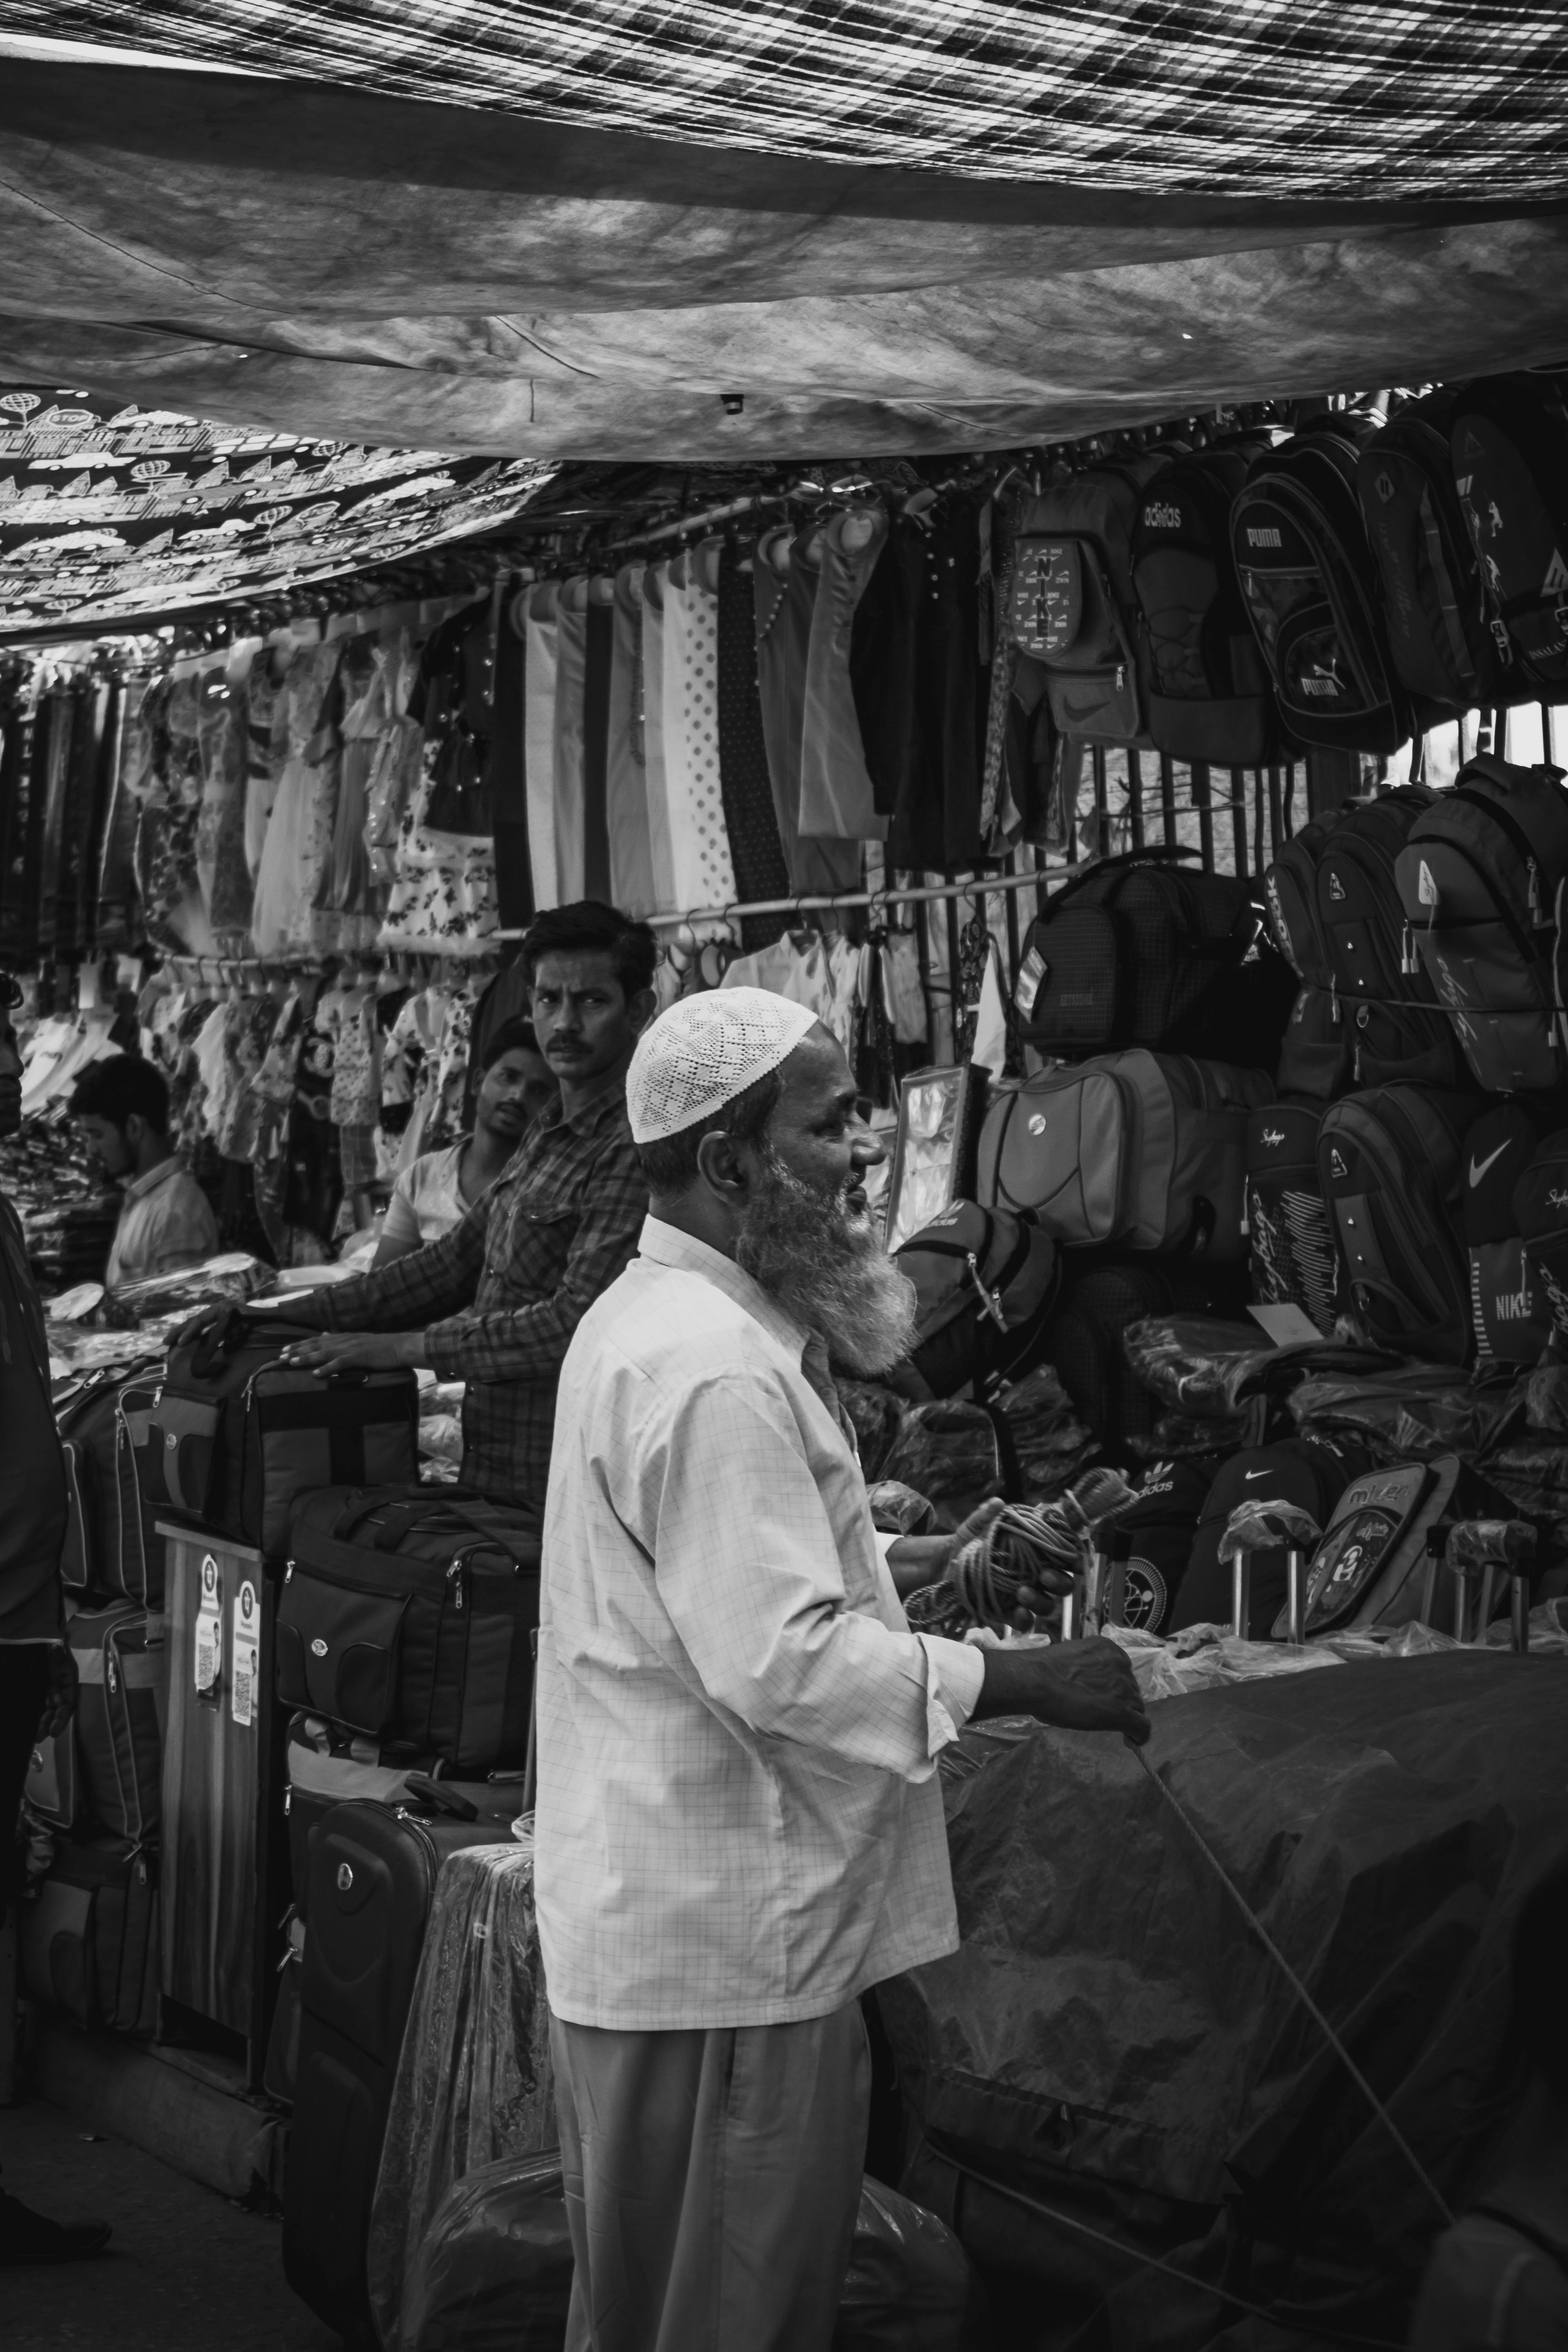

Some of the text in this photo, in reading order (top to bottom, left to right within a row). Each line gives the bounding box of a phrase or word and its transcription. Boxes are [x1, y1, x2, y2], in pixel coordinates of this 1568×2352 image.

[1247, 529, 1282, 547] PUMA
[1037, 558, 1051, 637] NIKE
[1301, 678, 1339, 696] PUMA
[1138, 1481, 1173, 1498] didas
